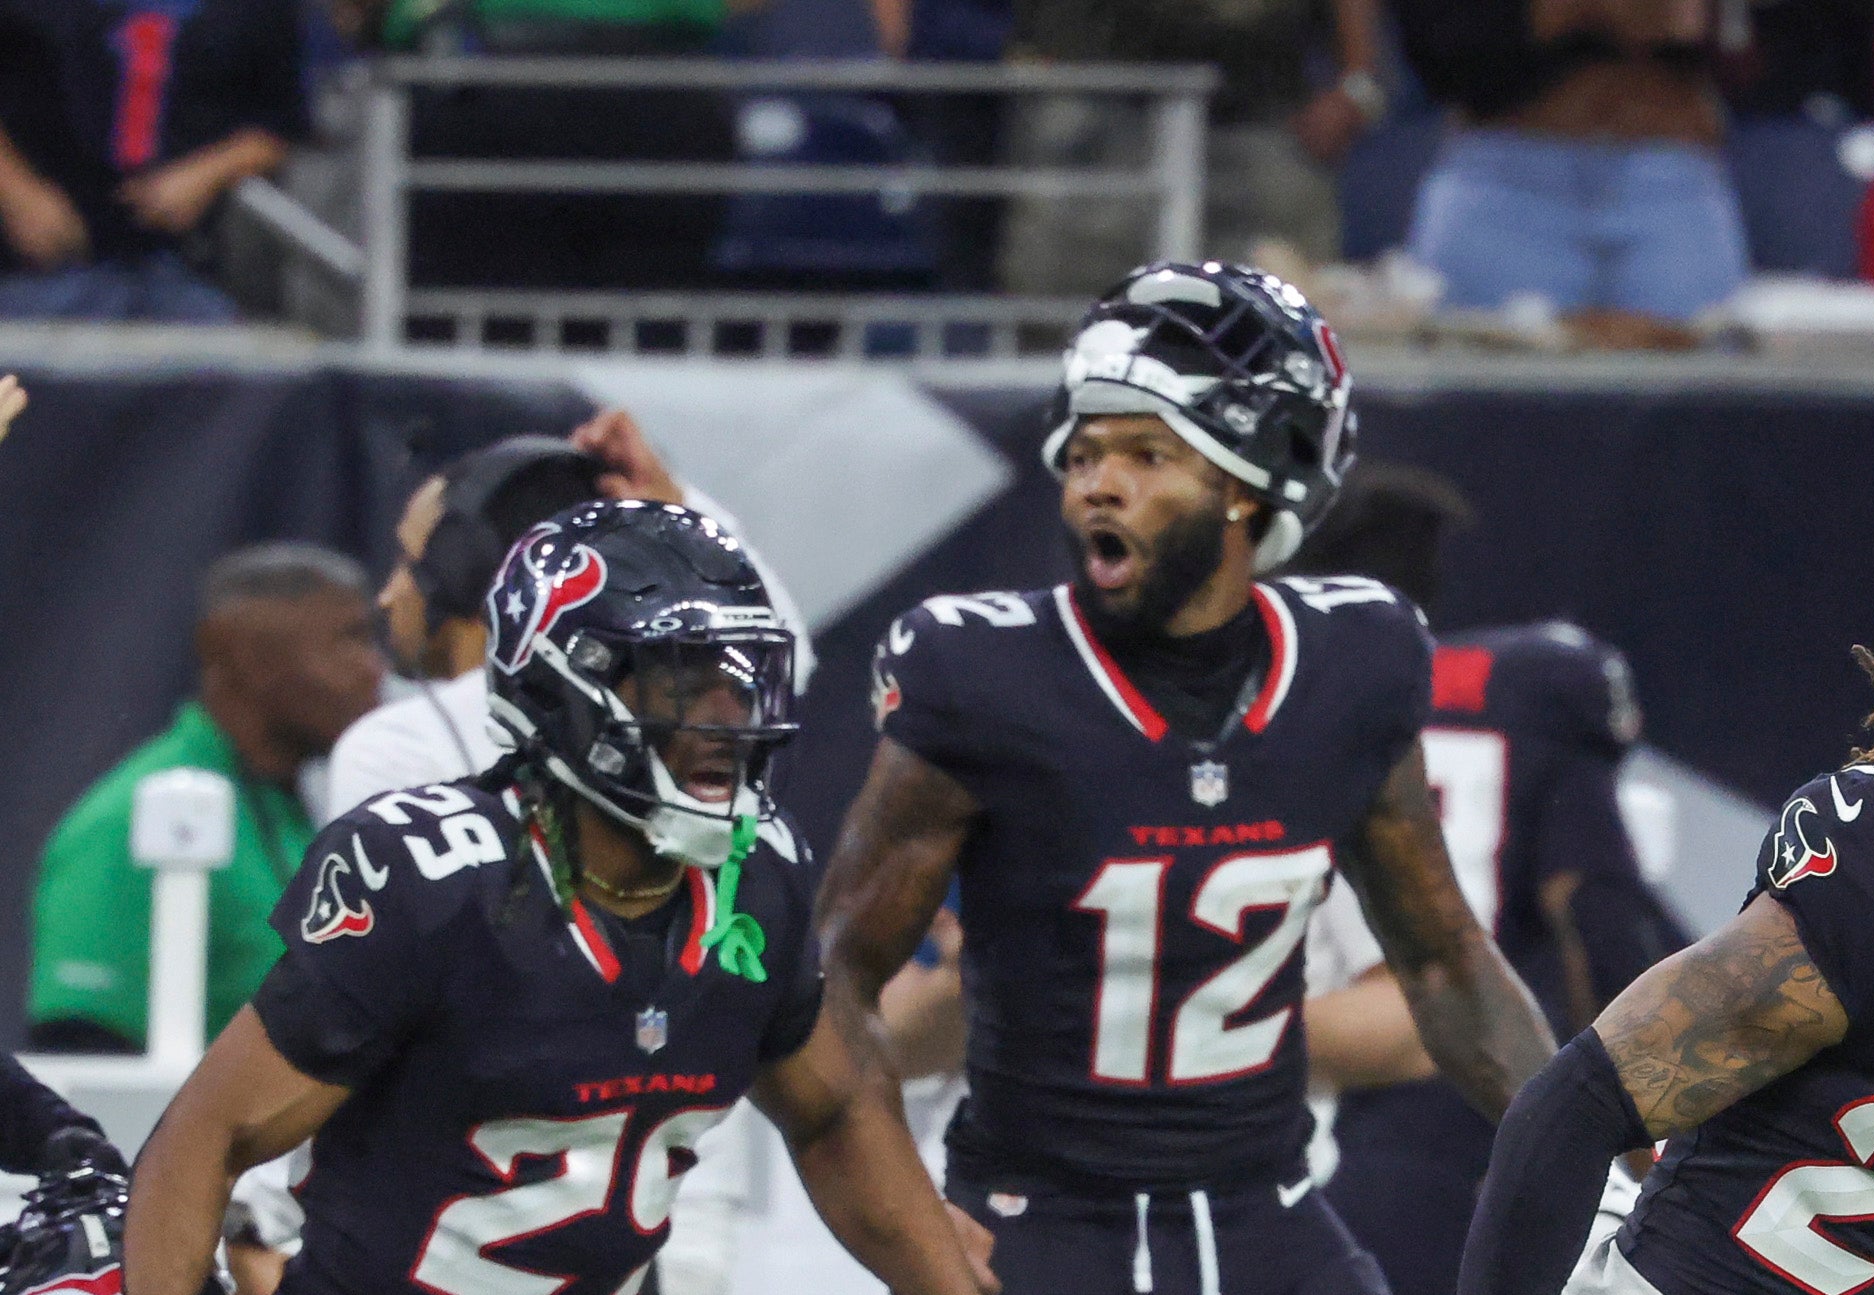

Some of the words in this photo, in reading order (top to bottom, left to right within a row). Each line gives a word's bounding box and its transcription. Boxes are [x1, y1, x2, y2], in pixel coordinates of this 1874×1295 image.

[367, 784, 508, 881] 29
[1128, 819, 1286, 847] TEXANS
[1074, 840, 1334, 1088] 12
[572, 1073, 718, 1103] TEXANS
